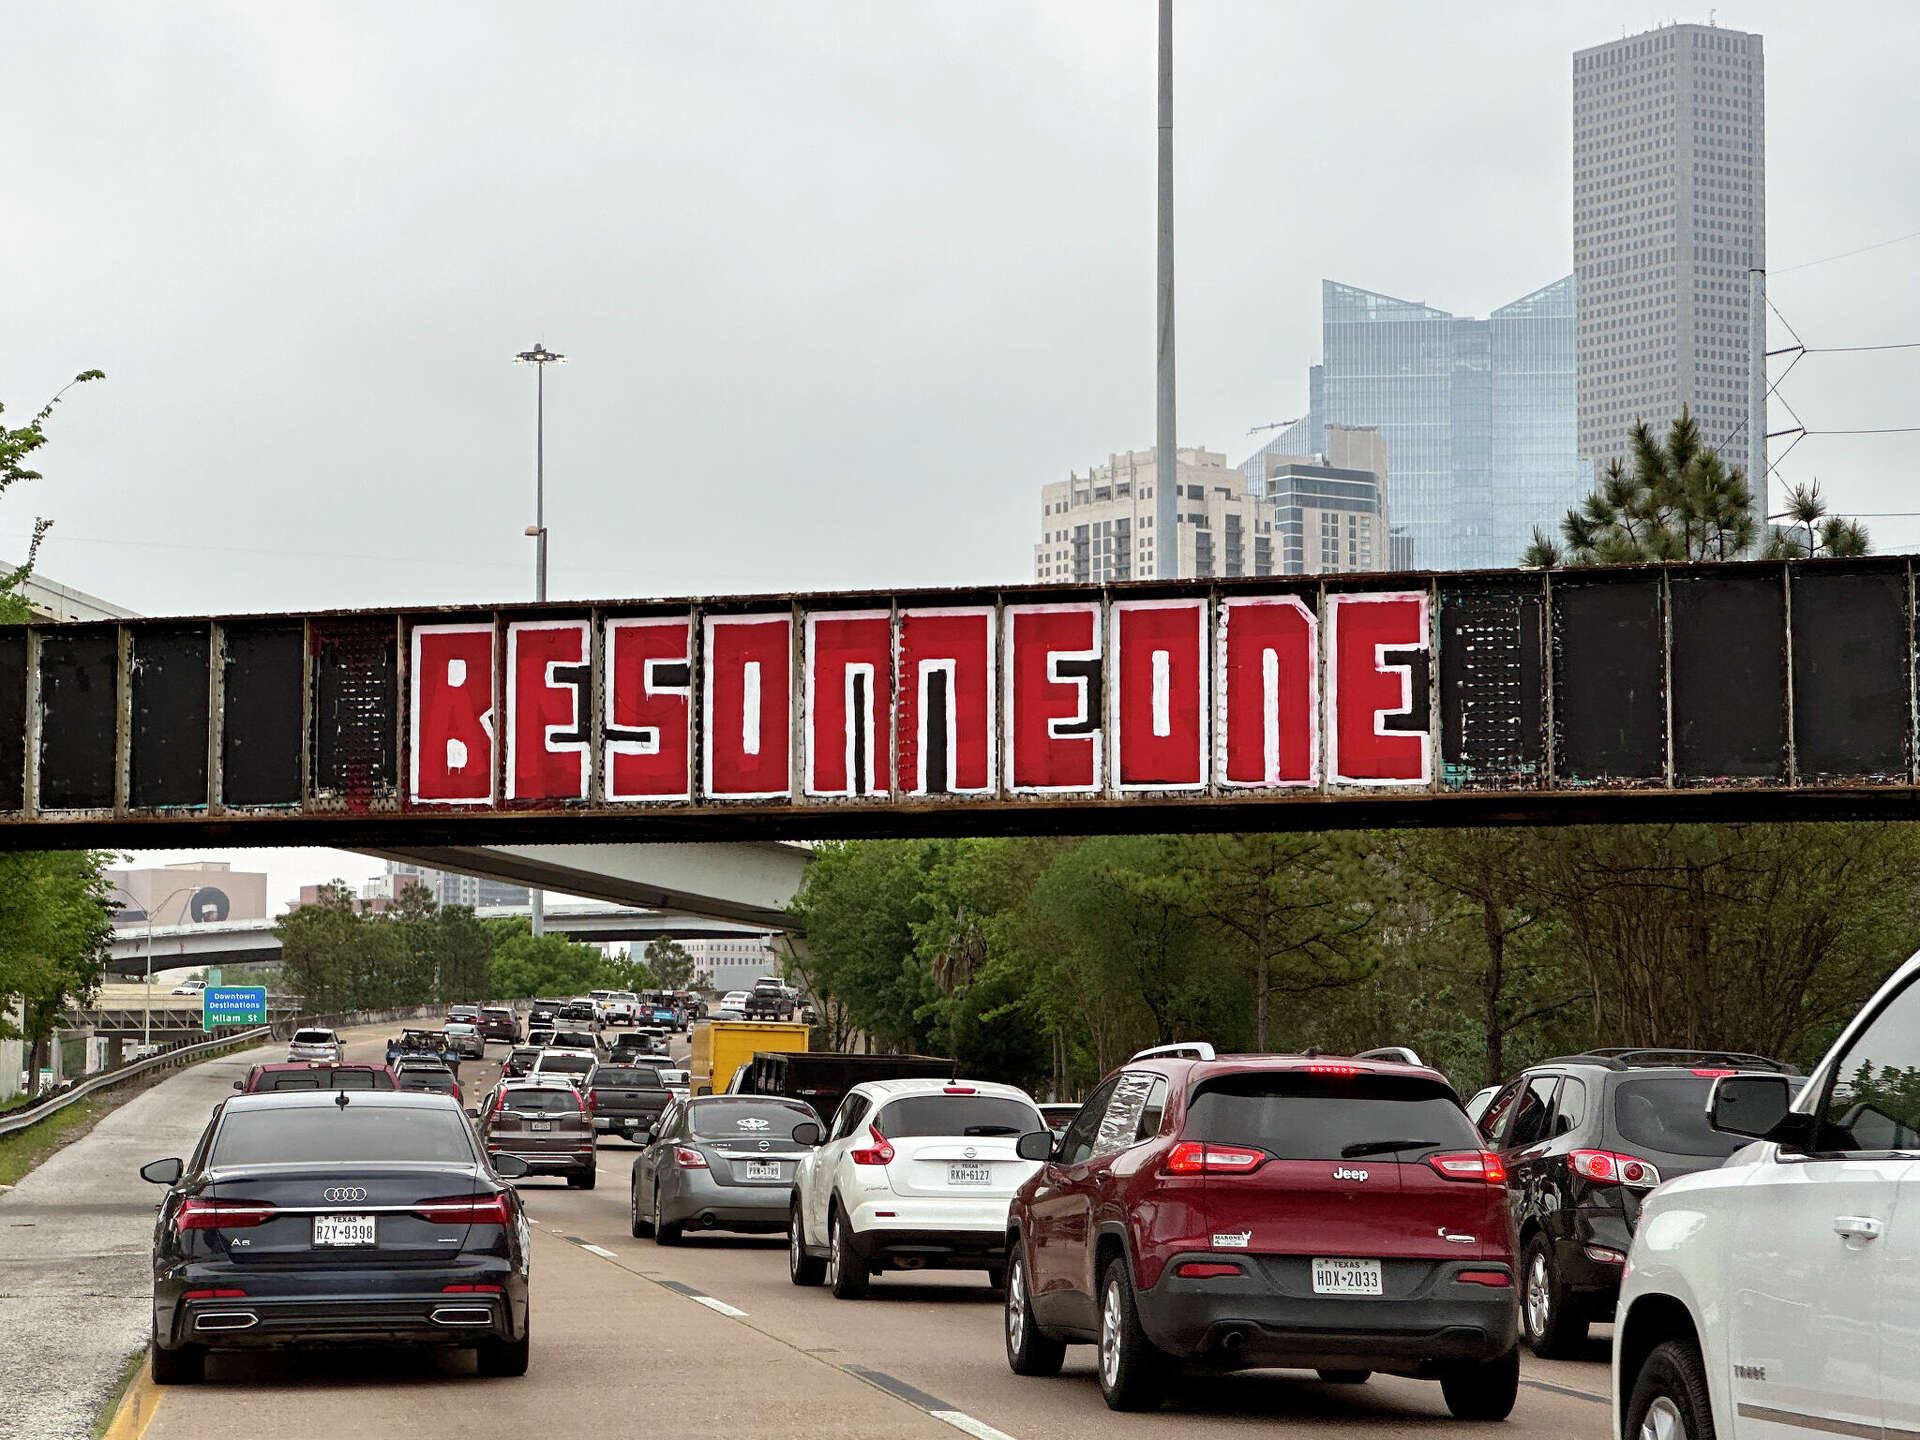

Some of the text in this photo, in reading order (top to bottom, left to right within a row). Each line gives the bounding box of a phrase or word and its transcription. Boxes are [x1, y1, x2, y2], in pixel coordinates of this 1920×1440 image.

[214, 992, 256, 1000] Downtown
[212, 1014, 258, 1023] Milam St
[1333, 1167, 1369, 1182] Jeep
[1333, 1260, 1361, 1269] TEXAS
